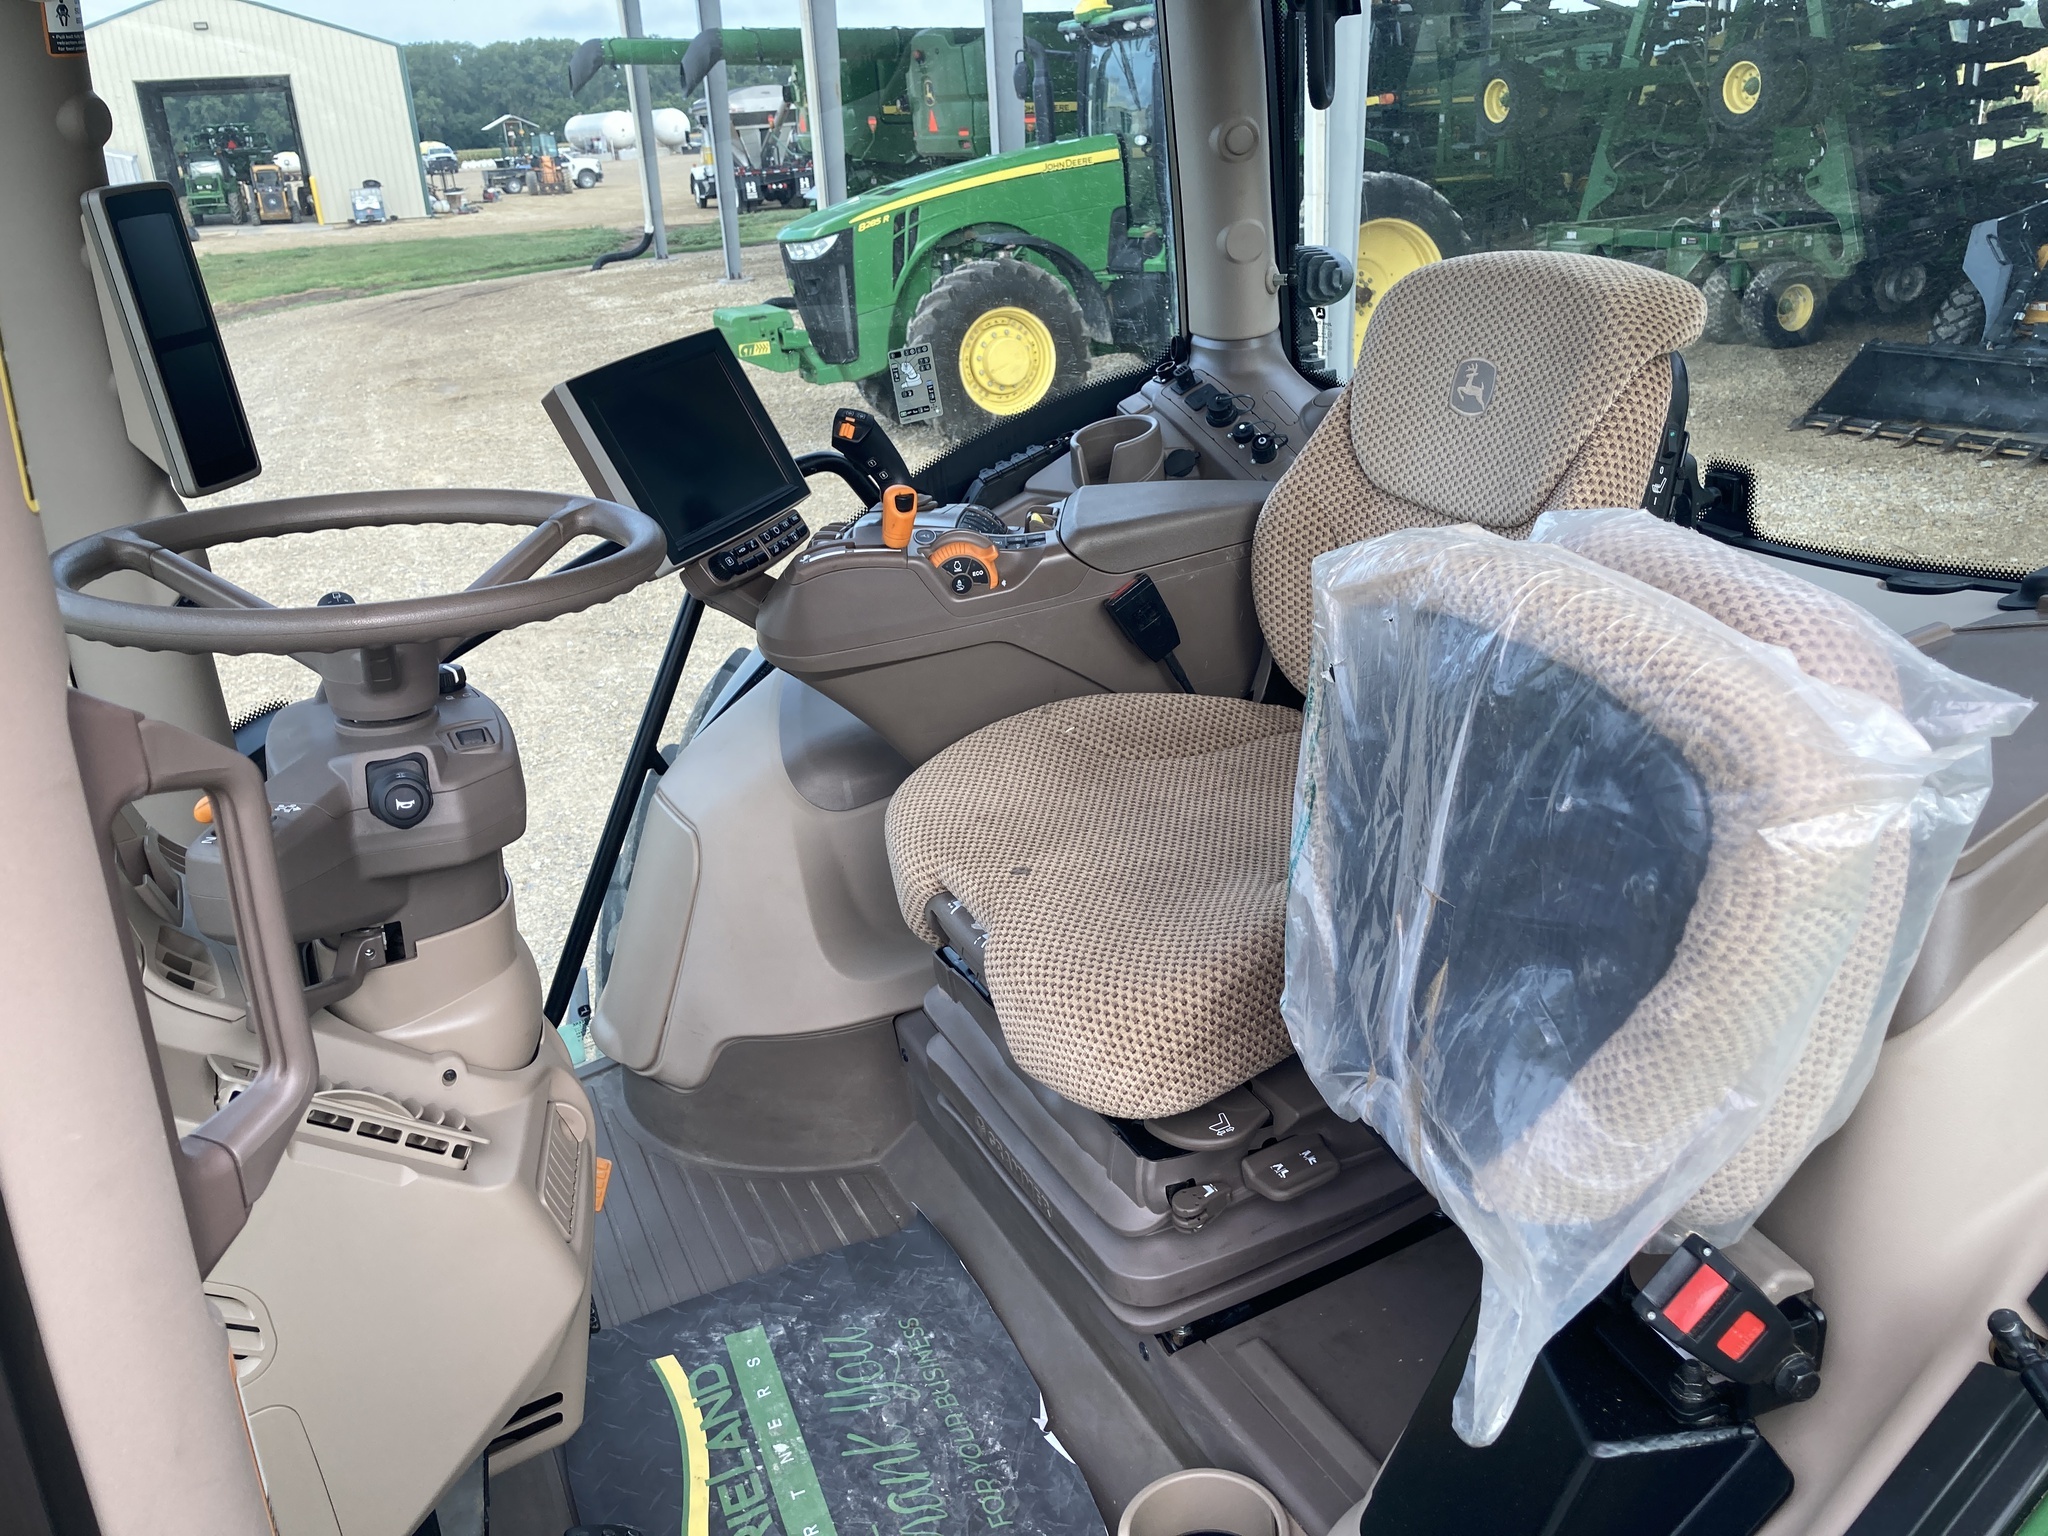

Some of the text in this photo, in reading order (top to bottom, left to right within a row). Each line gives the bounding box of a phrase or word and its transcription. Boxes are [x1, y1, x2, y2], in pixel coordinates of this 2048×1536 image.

[1043, 156, 1093, 172] JOHN DEERE
[898, 1317, 1014, 1529] FOR YOUR BUSINESS
